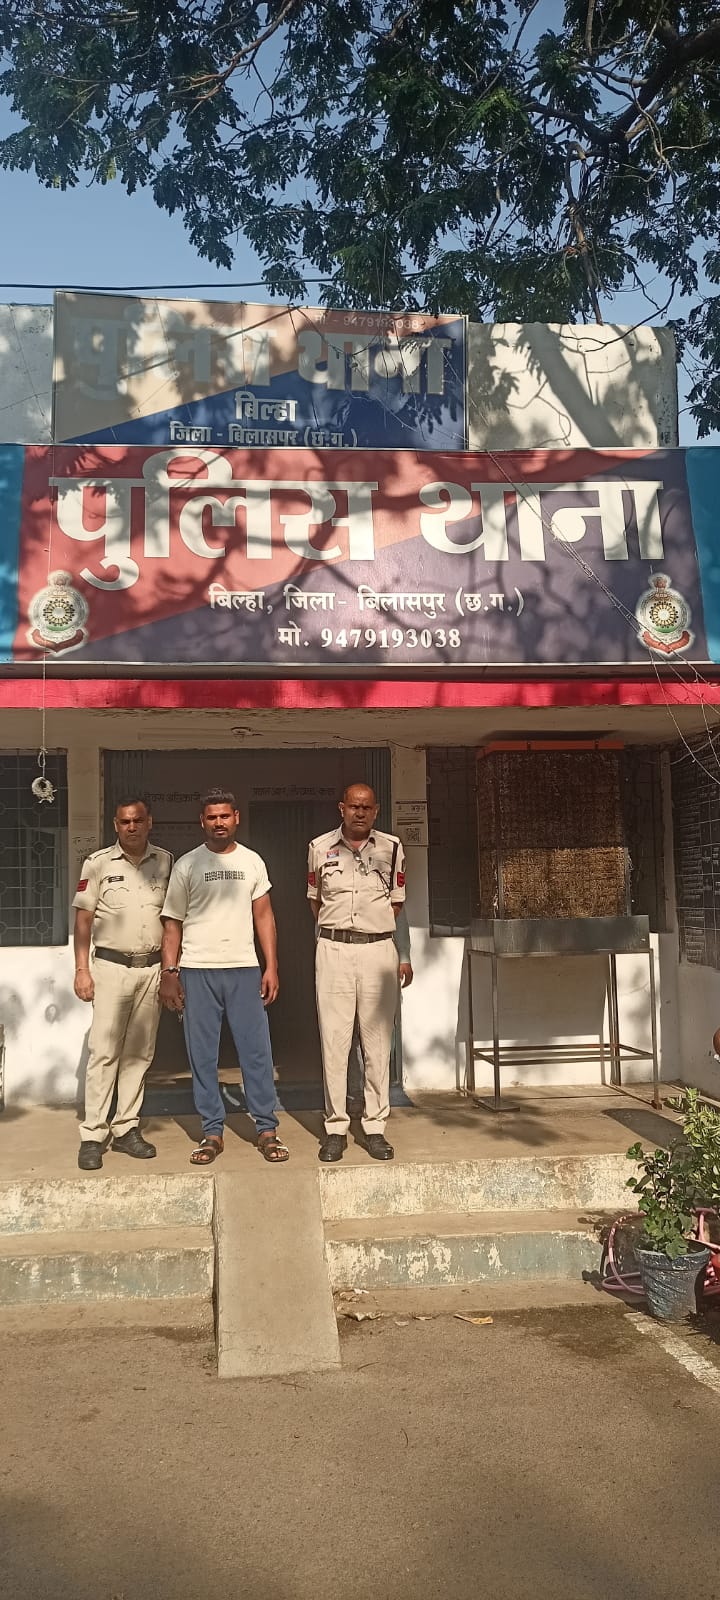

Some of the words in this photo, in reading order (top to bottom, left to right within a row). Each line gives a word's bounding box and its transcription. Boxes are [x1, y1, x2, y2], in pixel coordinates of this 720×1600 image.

[343, 315, 420, 329] 9479193038
[70, 304, 277, 400] पुलिस
[298, 329, 454, 395] थाना
[235, 391, 298, 422] बिल्हा
[169, 421, 212, 442] जिला
[228, 424, 298, 447] बिलासपर
[49, 448, 378, 591] पुलिस
[419, 480, 664, 561] थाना
[208, 583, 273, 615] बिल्हा,
[357, 585, 446, 619] बिलासपुर
[455, 587, 525, 617] (छ.ग.)
[278, 622, 310, 648] मो.
[321, 628, 462, 648] 9479193038
